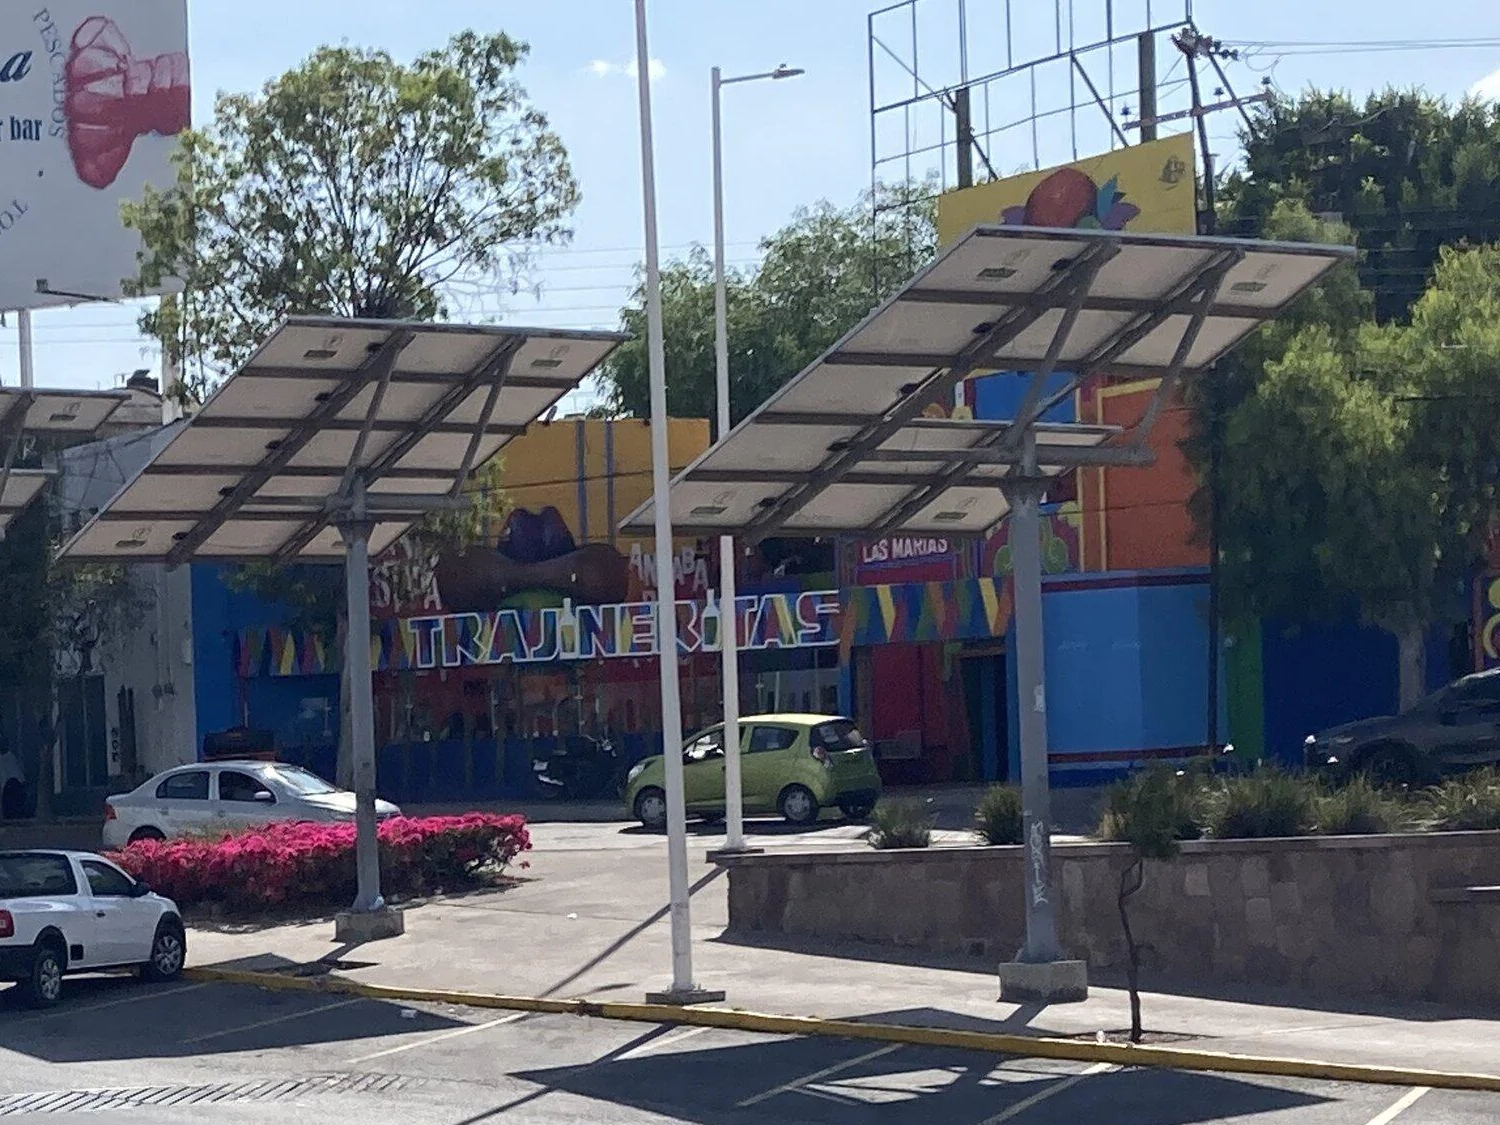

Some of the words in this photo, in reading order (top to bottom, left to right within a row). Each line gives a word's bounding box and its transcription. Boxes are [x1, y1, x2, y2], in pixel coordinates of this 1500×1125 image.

[32, 7, 67, 139] PESCADOS
[9, 115, 43, 142] bar
[862, 538, 888, 563] LAS
